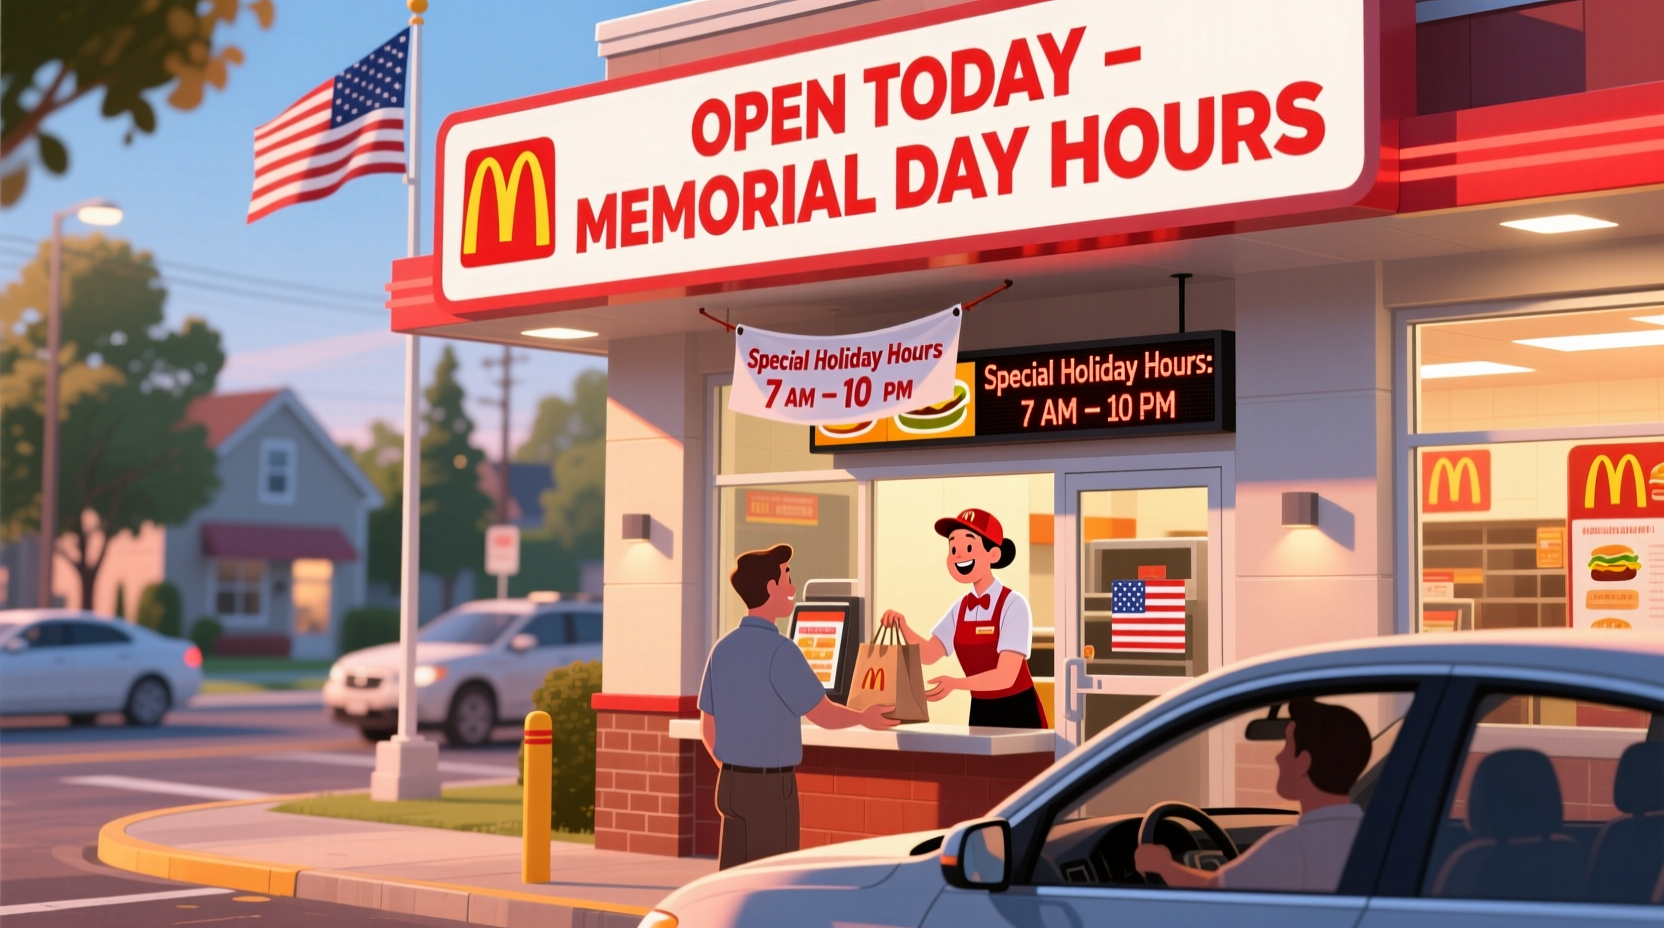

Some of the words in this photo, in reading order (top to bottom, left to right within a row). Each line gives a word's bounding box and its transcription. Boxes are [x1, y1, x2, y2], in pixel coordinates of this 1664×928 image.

[691, 74, 846, 157] OPEN
[863, 26, 1087, 128] TODAY
[576, 153, 877, 254] MEMORIAL
[895, 125, 1030, 210] DAY
[1051, 80, 1326, 188] HOURS
[746, 346, 811, 375] Special
[814, 345, 882, 372] Holiday
[887, 341, 943, 365] Hours
[984, 359, 1054, 397] Special
[1060, 353, 1138, 386] Holiday
[1144, 350, 1213, 379] Hours:
[764, 377, 783, 410] 7
[784, 386, 816, 409] AM
[843, 376, 873, 409] 10
[882, 379, 914, 403] PM
[1021, 399, 1035, 428] 7
[1040, 397, 1077, 426] AM
[1107, 393, 1133, 422] 10
[1139, 390, 1176, 420] PM
